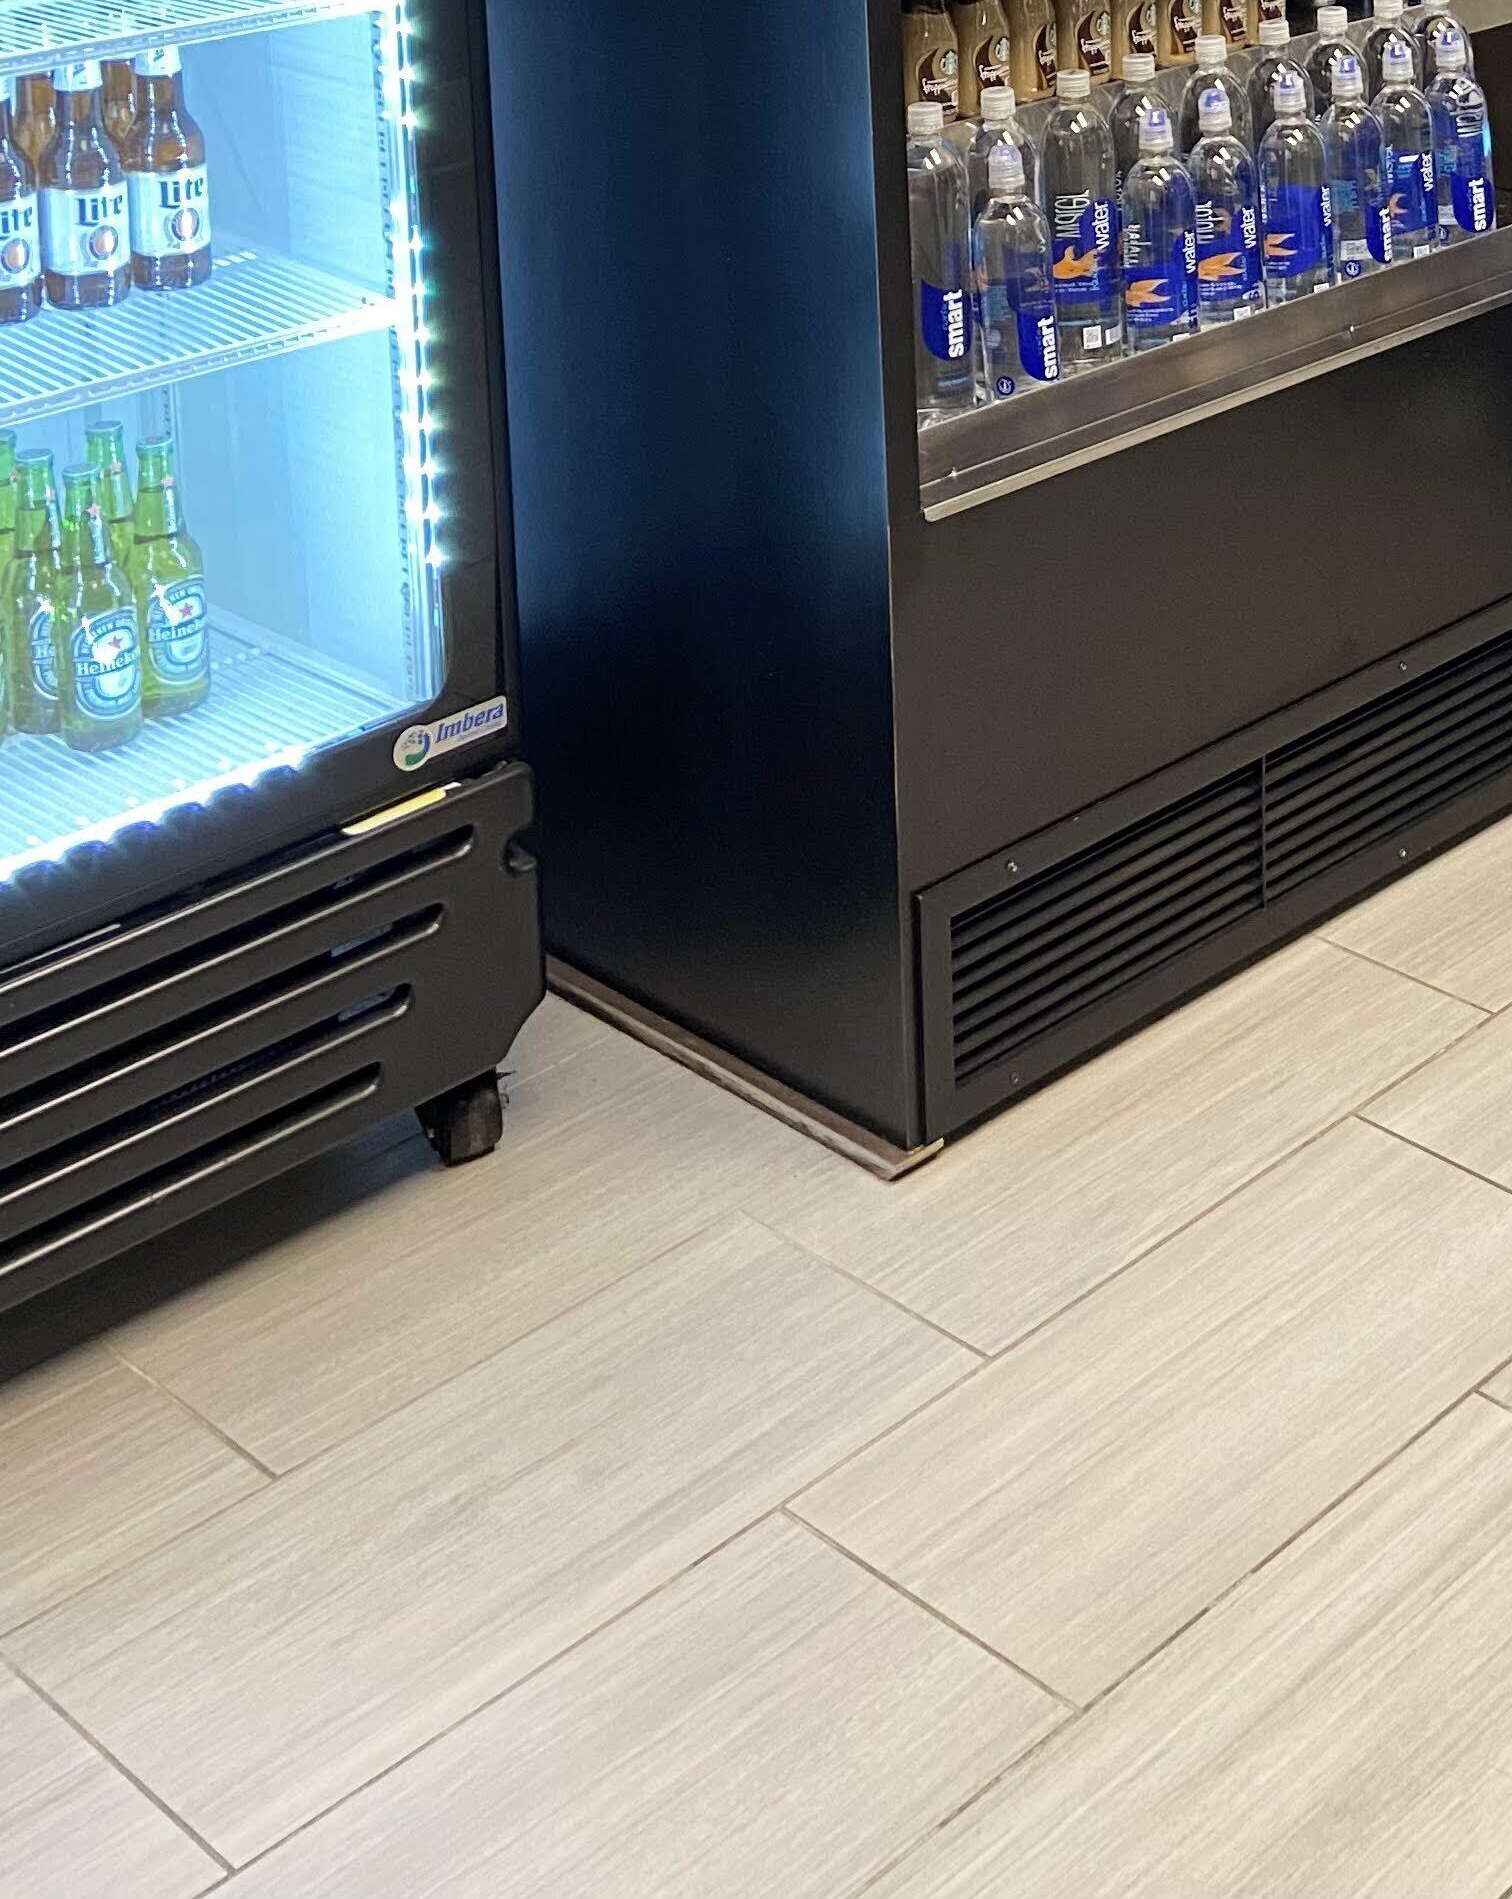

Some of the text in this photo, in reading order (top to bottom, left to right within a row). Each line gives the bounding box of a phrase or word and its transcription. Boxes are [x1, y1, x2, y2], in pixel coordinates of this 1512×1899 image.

[158, 176, 204, 210] Lite
[1420, 152, 1434, 192] water
[0, 205, 33, 239] ite
[78, 193, 123, 227] Lite
[1092, 201, 1110, 252] water
[1468, 178, 1487, 232] smart
[1245, 207, 1258, 250] water
[1183, 231, 1197, 274] water
[943, 289, 964, 358] smart
[1037, 316, 1058, 379] smart
[435, 702, 504, 744] Imbera
